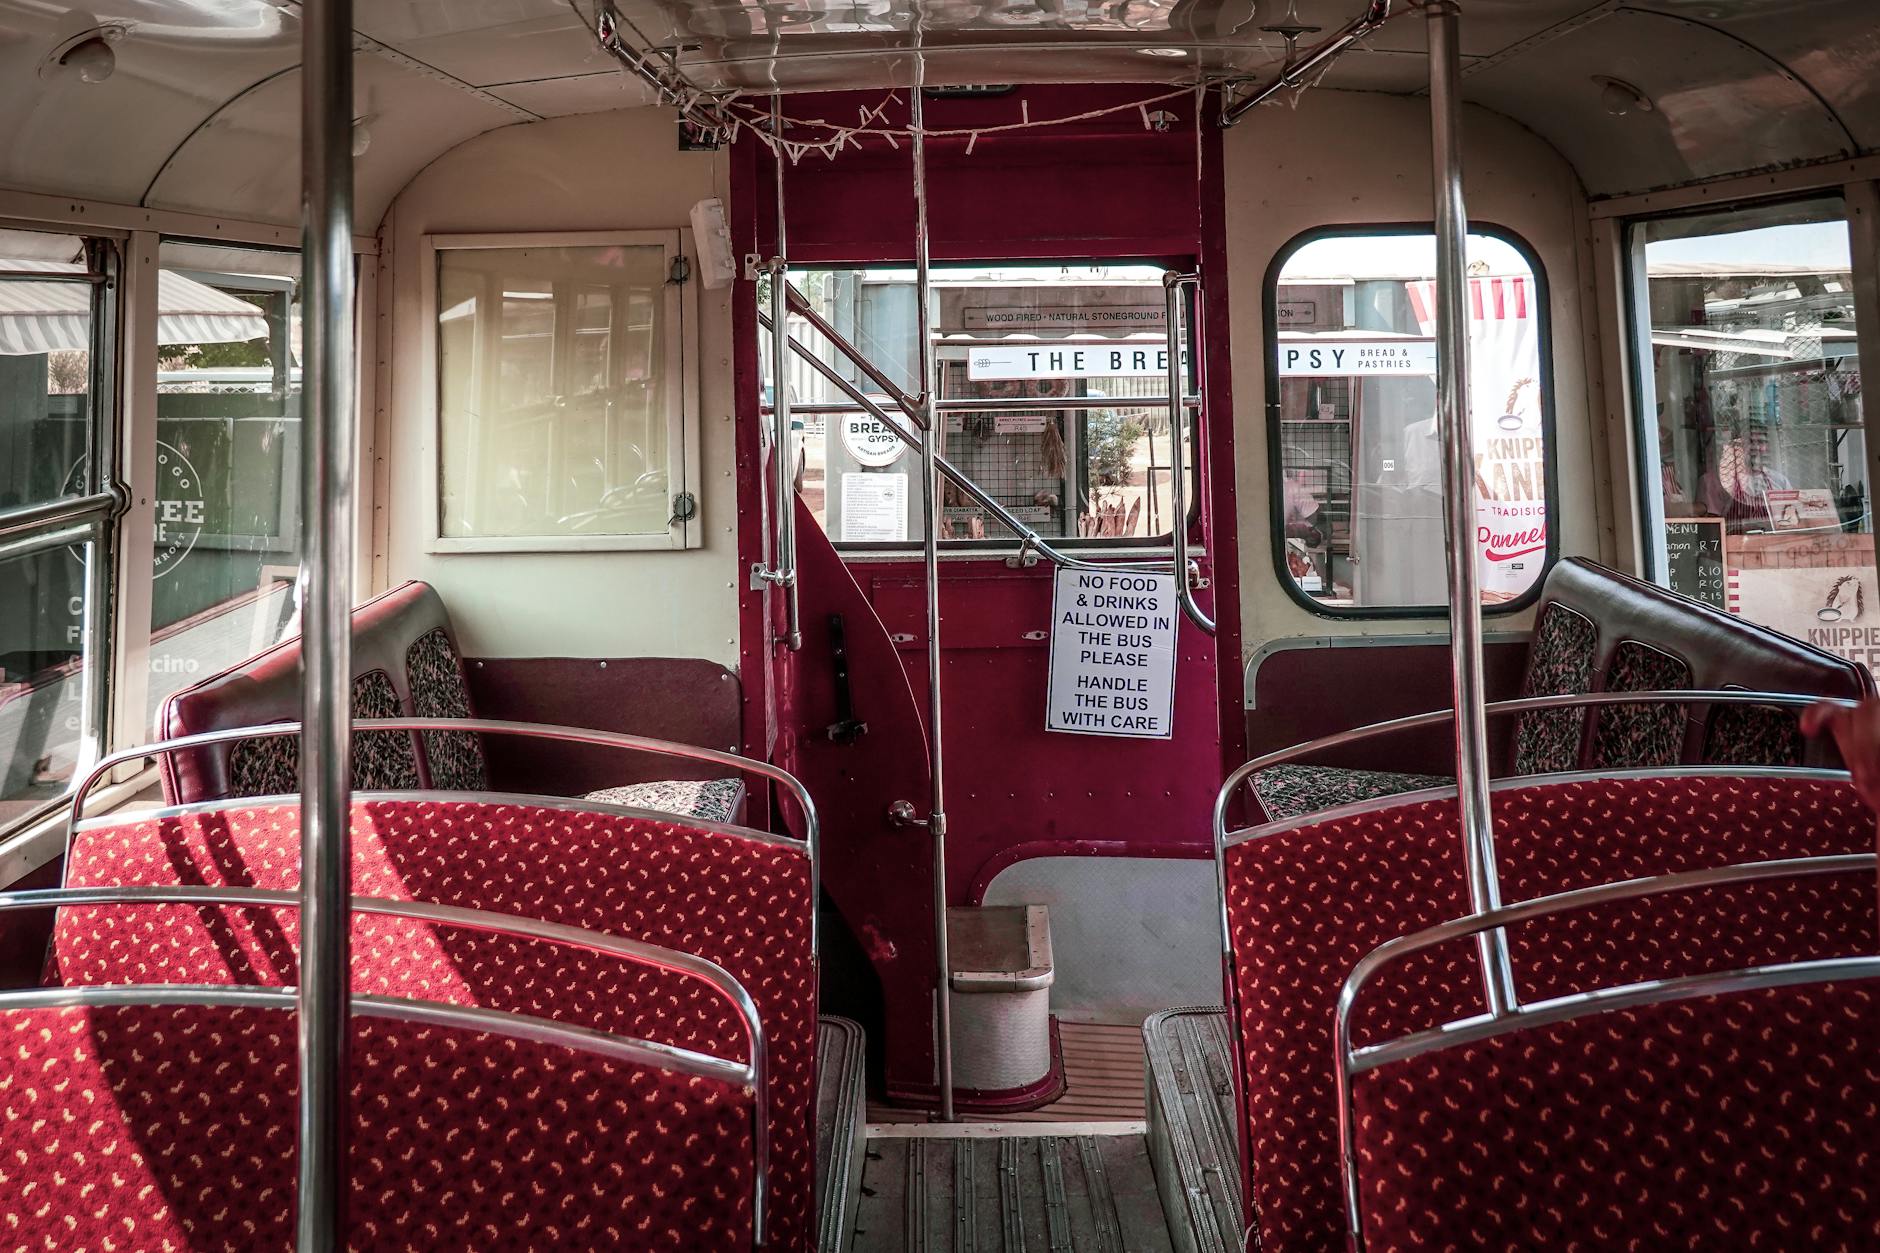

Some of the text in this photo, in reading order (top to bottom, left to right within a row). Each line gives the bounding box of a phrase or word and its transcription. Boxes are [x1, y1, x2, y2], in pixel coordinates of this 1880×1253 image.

[986, 313, 1014, 322] WOOD
[1016, 313, 1042, 322] FIRED
[1049, 313, 1090, 321] NATURAL
[1091, 312, 1160, 321] STONEGROUND
[1027, 351, 1085, 371] THE
[1360, 348, 1408, 357] BREAD &
[1358, 359, 1411, 368] PASTRIES
[1665, 523, 1699, 534] MENU
[1079, 575, 1158, 592] NO FOOD
[1076, 593, 1158, 611] & DRINKS
[1062, 611, 1170, 630] ALLOWED IN
[1078, 631, 1152, 648] THE BUS
[1080, 650, 1148, 667] PLEASE
[1077, 675, 1148, 692] HANDLE
[1074, 693, 1148, 711] THE BUS
[1062, 711, 1159, 730] WITH CARE
